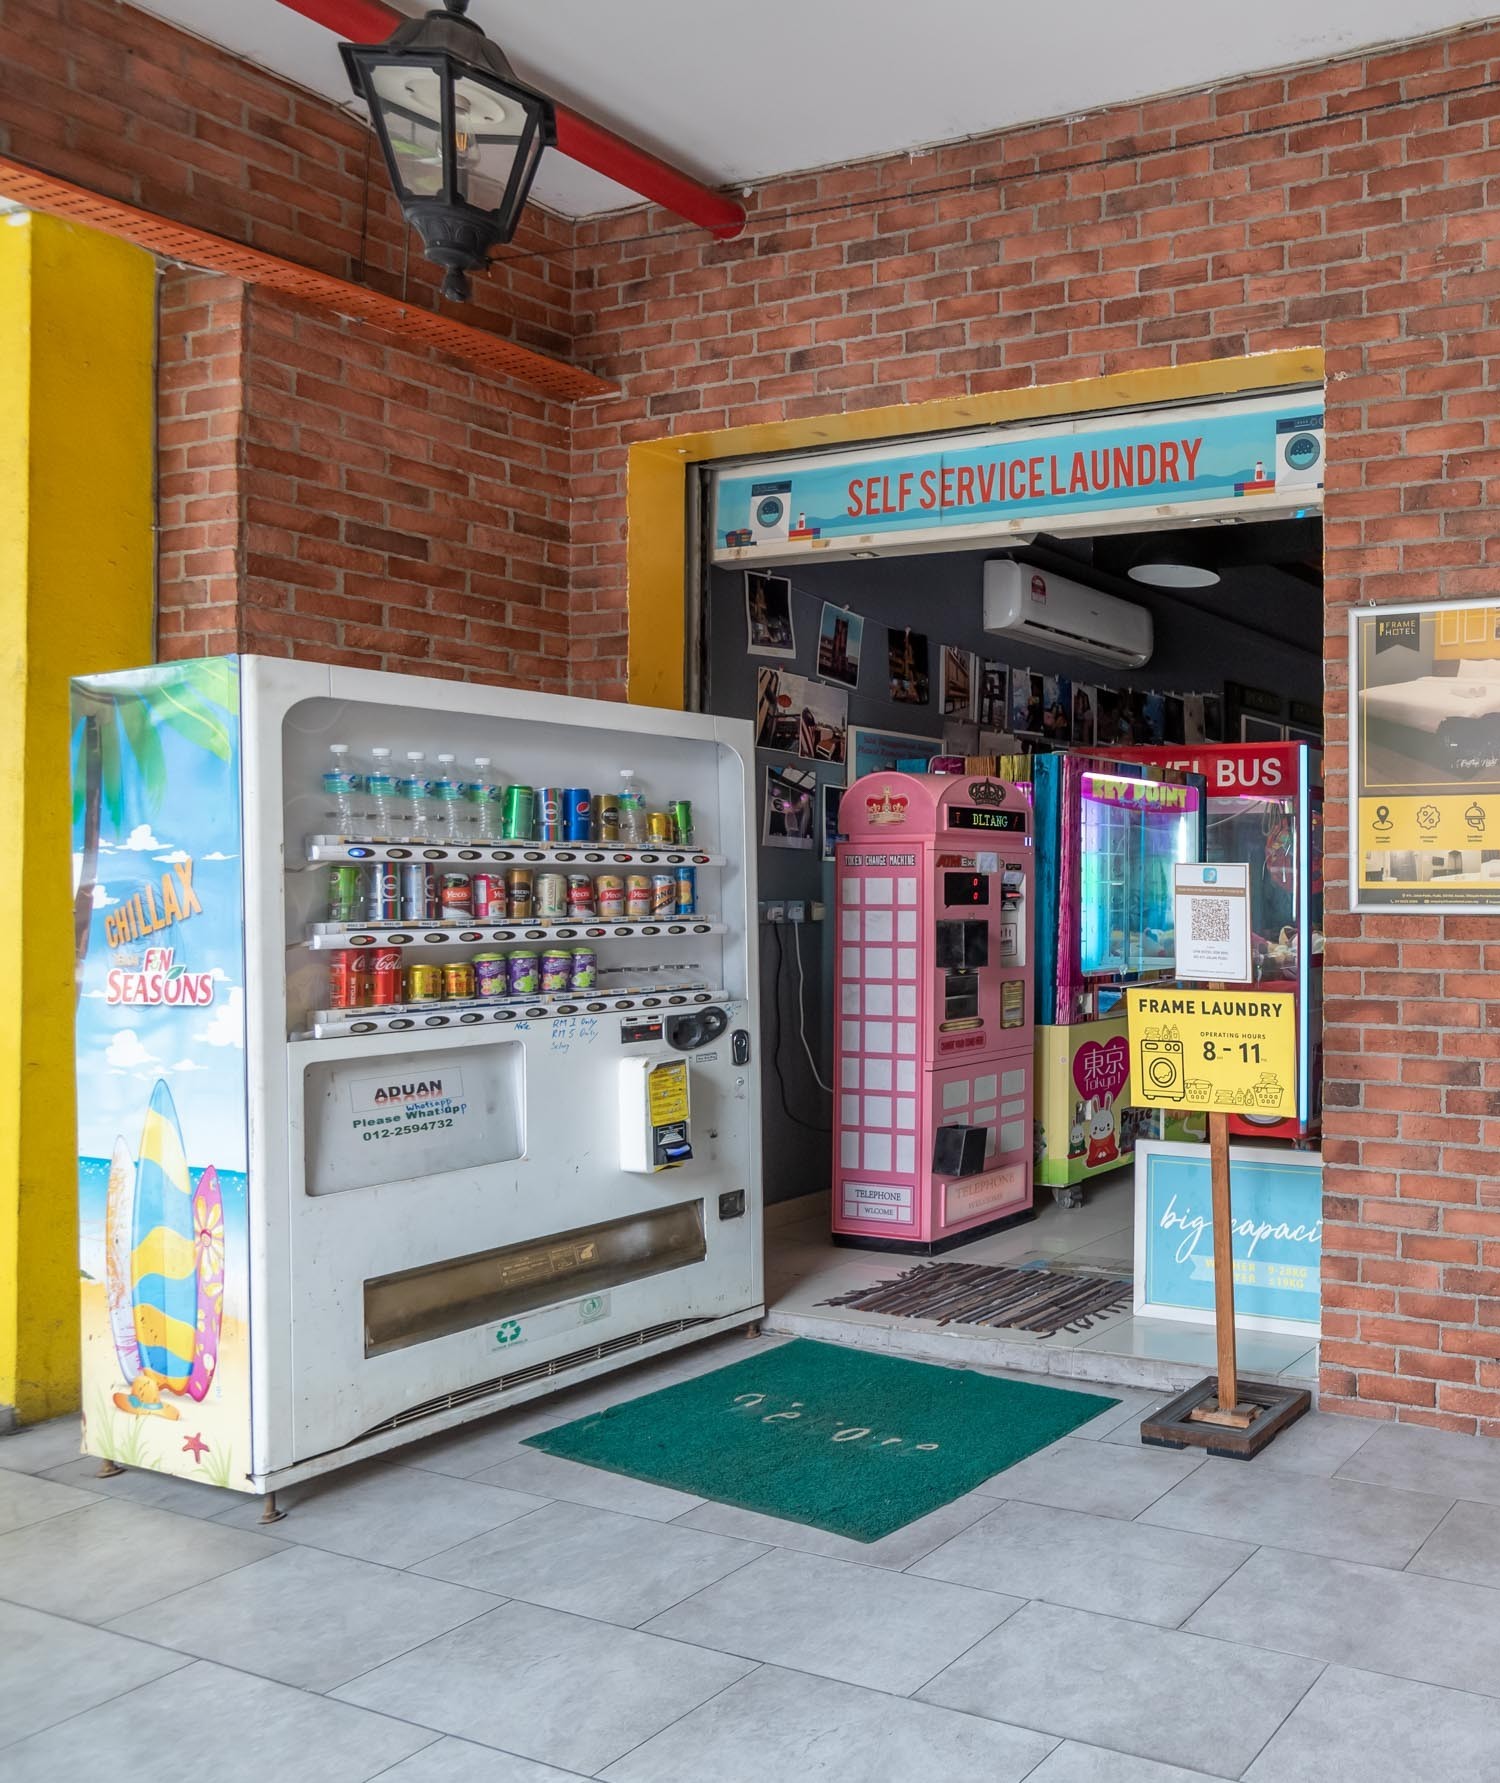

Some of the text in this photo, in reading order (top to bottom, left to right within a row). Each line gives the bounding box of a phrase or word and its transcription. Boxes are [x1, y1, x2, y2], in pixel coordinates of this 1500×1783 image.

[847, 437, 1202, 518] SELF SERVICE LAUNDRY
[1385, 620, 1415, 629] FRAME
[1386, 628, 1416, 636] HOTEL
[1216, 758, 1282, 788] BUS
[1093, 778, 1129, 799] KEY
[1134, 784, 1187, 808] POINT
[845, 855, 916, 866] TOKEN CHANGE MACHINE
[105, 858, 202, 949] CHILLAX
[108, 970, 212, 1004] SEASONS
[1139, 998, 1283, 1018] FRAME LAUNDRY
[552, 1019, 567, 1028] RM
[552, 1030, 565, 1038] RM
[1083, 1044, 1125, 1080] 東京
[1203, 1041, 1216, 1061] 8
[1239, 1043, 1260, 1063] 11
[375, 1080, 442, 1097] ADUAN
[353, 1116, 401, 1128] Please
[363, 1118, 453, 1142] 012-2594732
[856, 1189, 902, 1201] TELEPHONE
[956, 1172, 1016, 1199] TELEPHONE
[1160, 1194, 1322, 1264] big capaci
